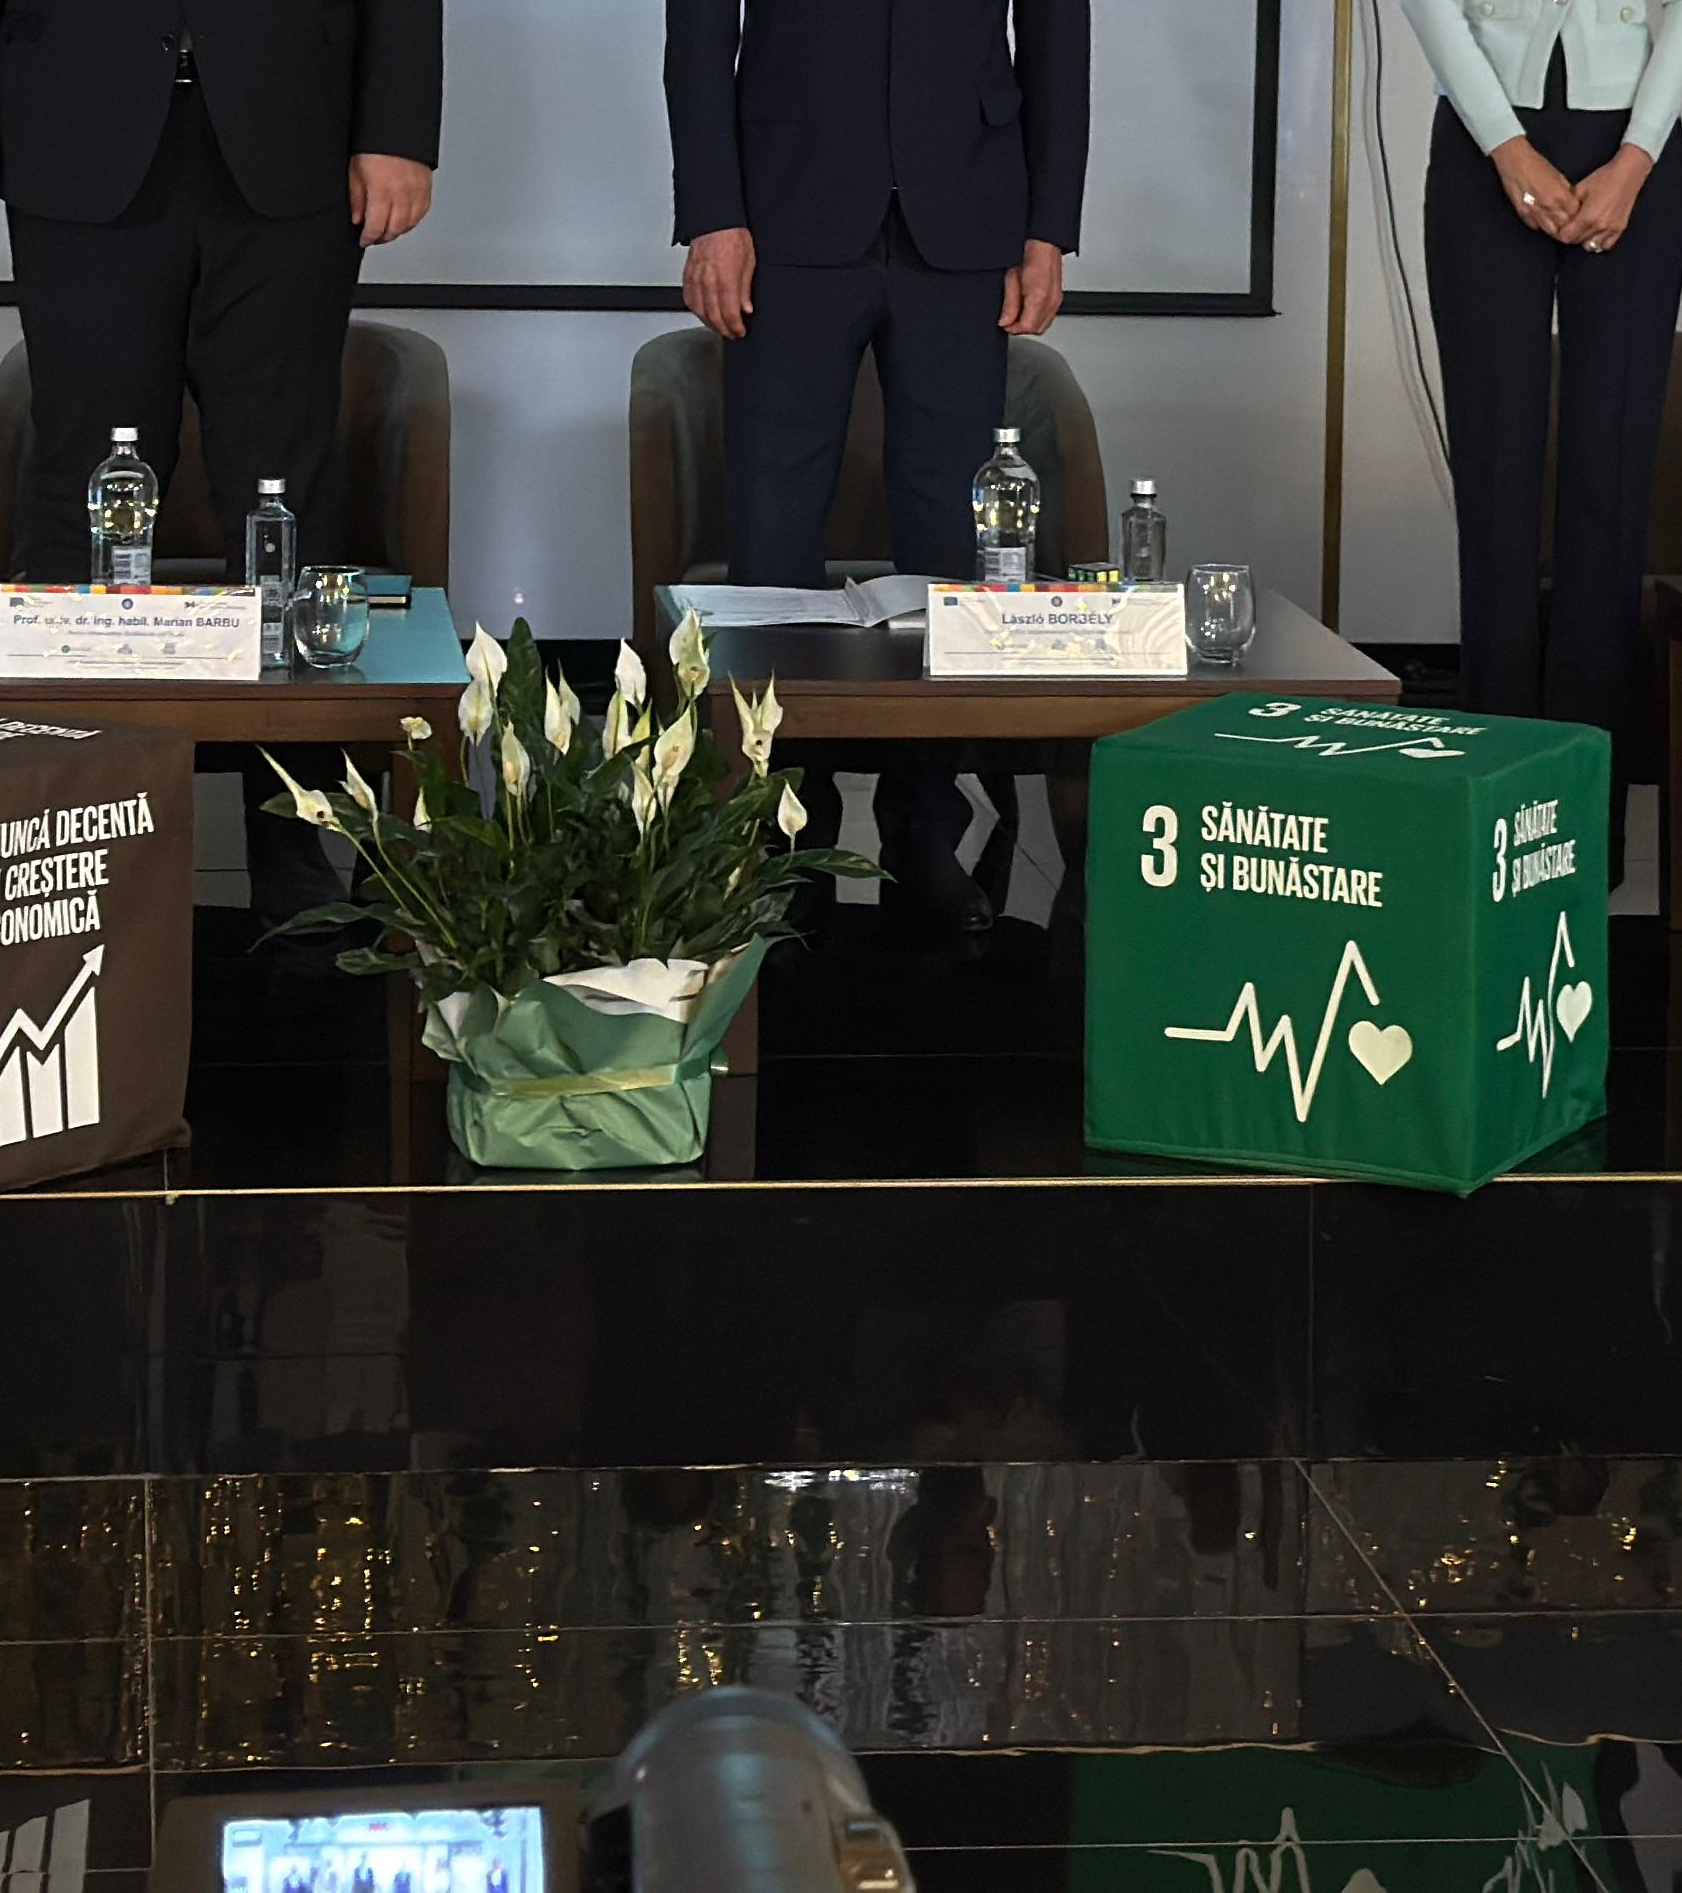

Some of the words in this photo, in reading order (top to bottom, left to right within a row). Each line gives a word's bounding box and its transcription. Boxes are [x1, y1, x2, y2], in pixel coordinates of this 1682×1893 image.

[196, 615, 240, 628] BARBU
[55, 792, 155, 848] DECENTĂ
[1140, 805, 1179, 888] 3
[1200, 801, 1329, 855] SĂNĂTATE
[5, 848, 109, 904] CREȘTERE
[1200, 854, 1225, 892] ȘI
[1231, 856, 1383, 908] BUNĂSTARE
[1492, 818, 1508, 903] 3
